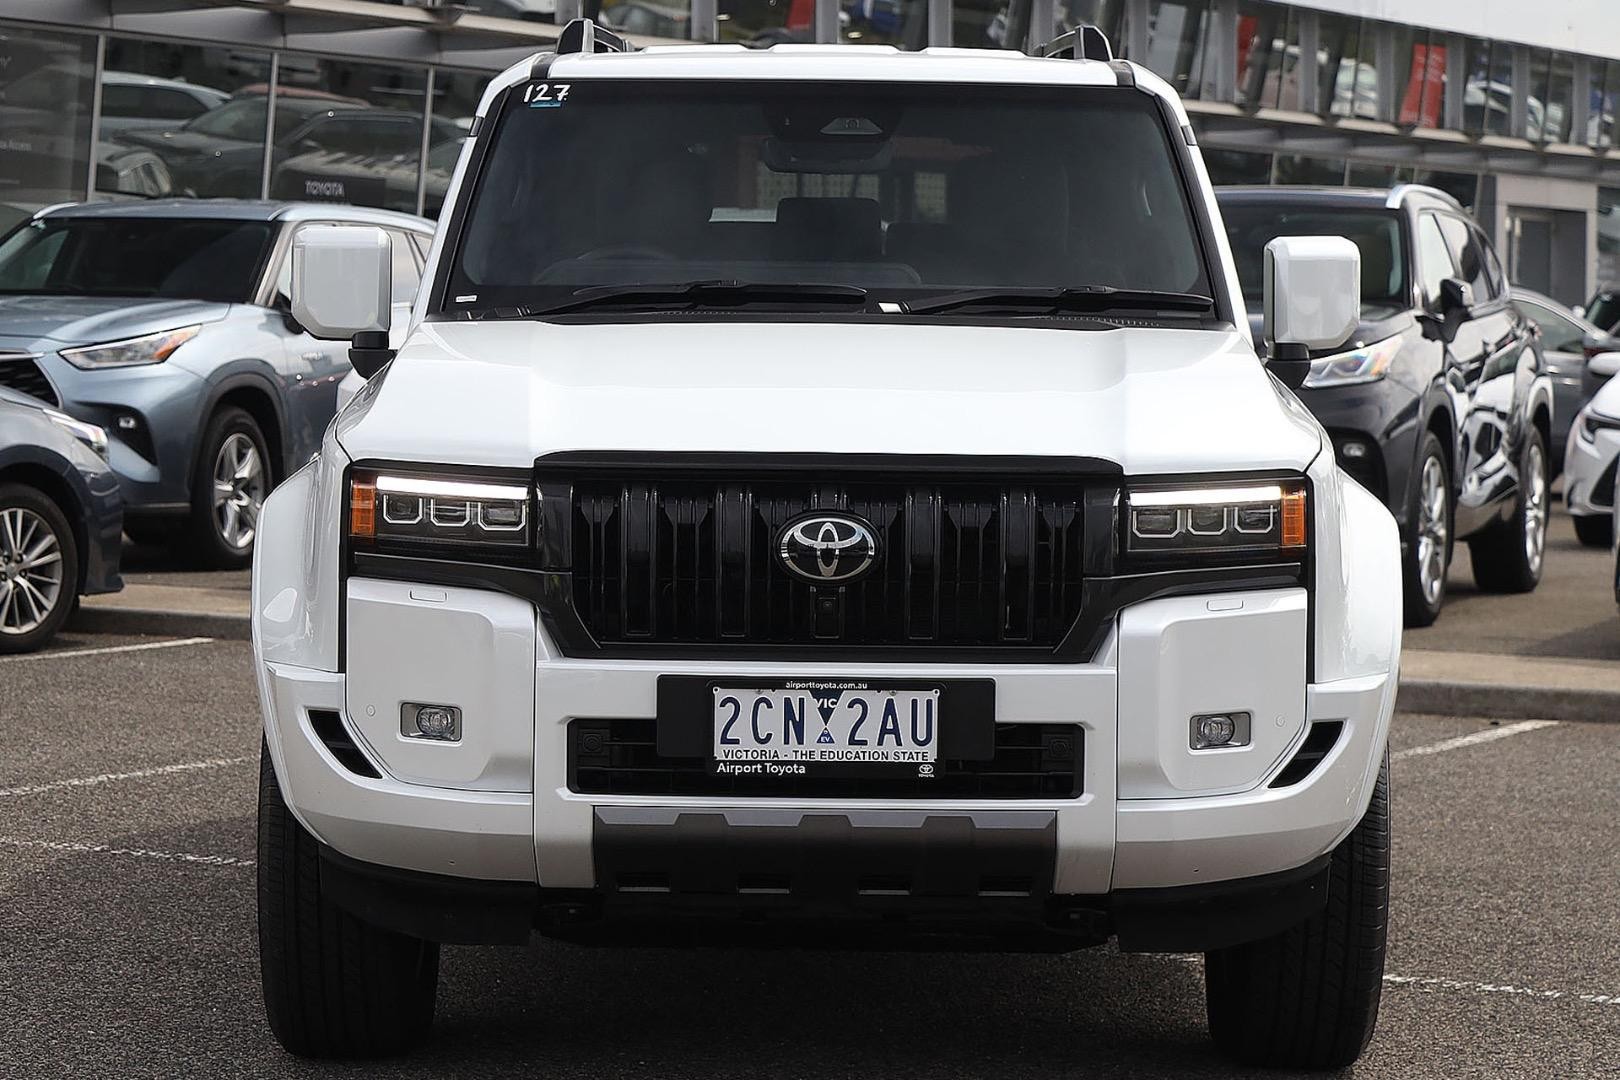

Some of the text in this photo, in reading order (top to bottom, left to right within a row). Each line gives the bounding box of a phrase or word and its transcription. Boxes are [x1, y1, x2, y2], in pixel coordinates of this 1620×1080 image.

[523, 83, 571, 102] 127
[305, 180, 344, 197] TOYOTA
[785, 681, 868, 690] airporttoyota.com.au
[815, 698, 838, 708] VIC
[719, 696, 933, 747] 2CN 2AU
[723, 749, 780, 760] VICTORIA
[792, 750, 816, 760] THE
[820, 750, 889, 761] EDUCATION
[893, 751, 929, 762] STATE
[716, 762, 806, 776] Airport Toyota
